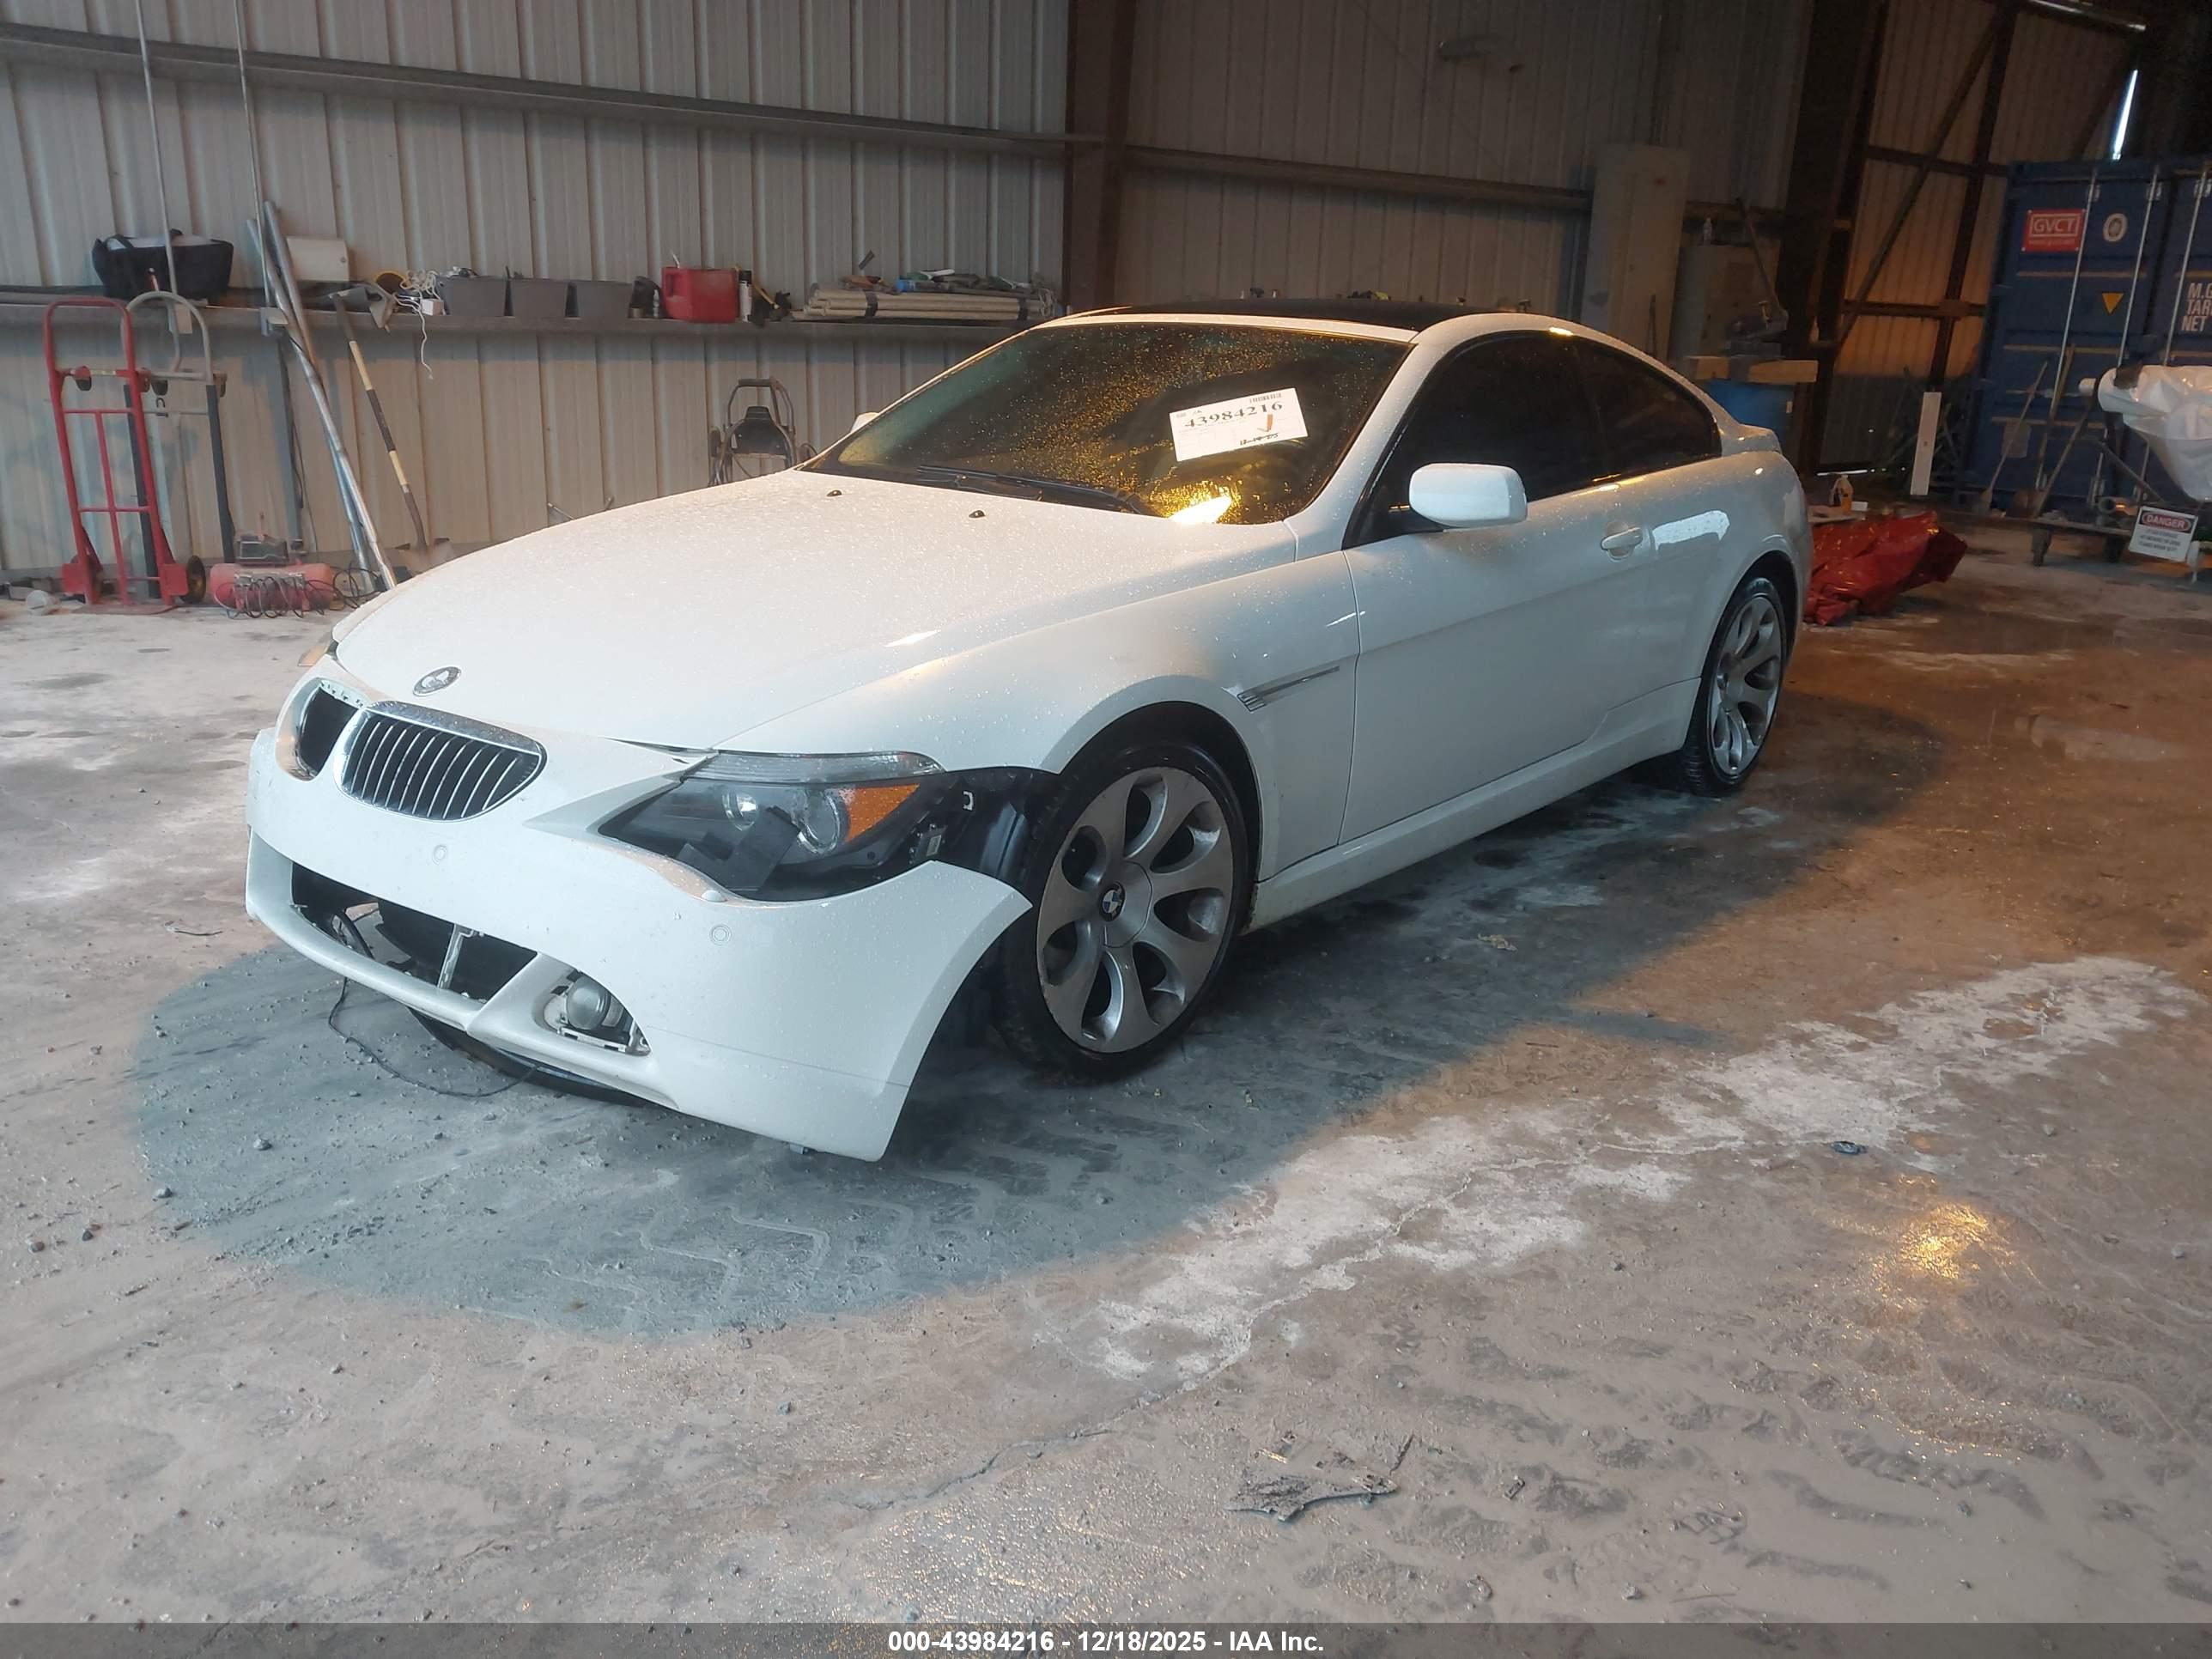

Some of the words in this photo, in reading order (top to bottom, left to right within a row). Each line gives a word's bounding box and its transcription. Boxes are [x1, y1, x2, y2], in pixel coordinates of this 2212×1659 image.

[2033, 218, 2075, 233] GVCT
[2186, 299, 2212, 315] TAR
[2181, 315, 2207, 331] NET
[1184, 401, 1283, 428] 43984216
[2147, 514, 2185, 529] DANGER
